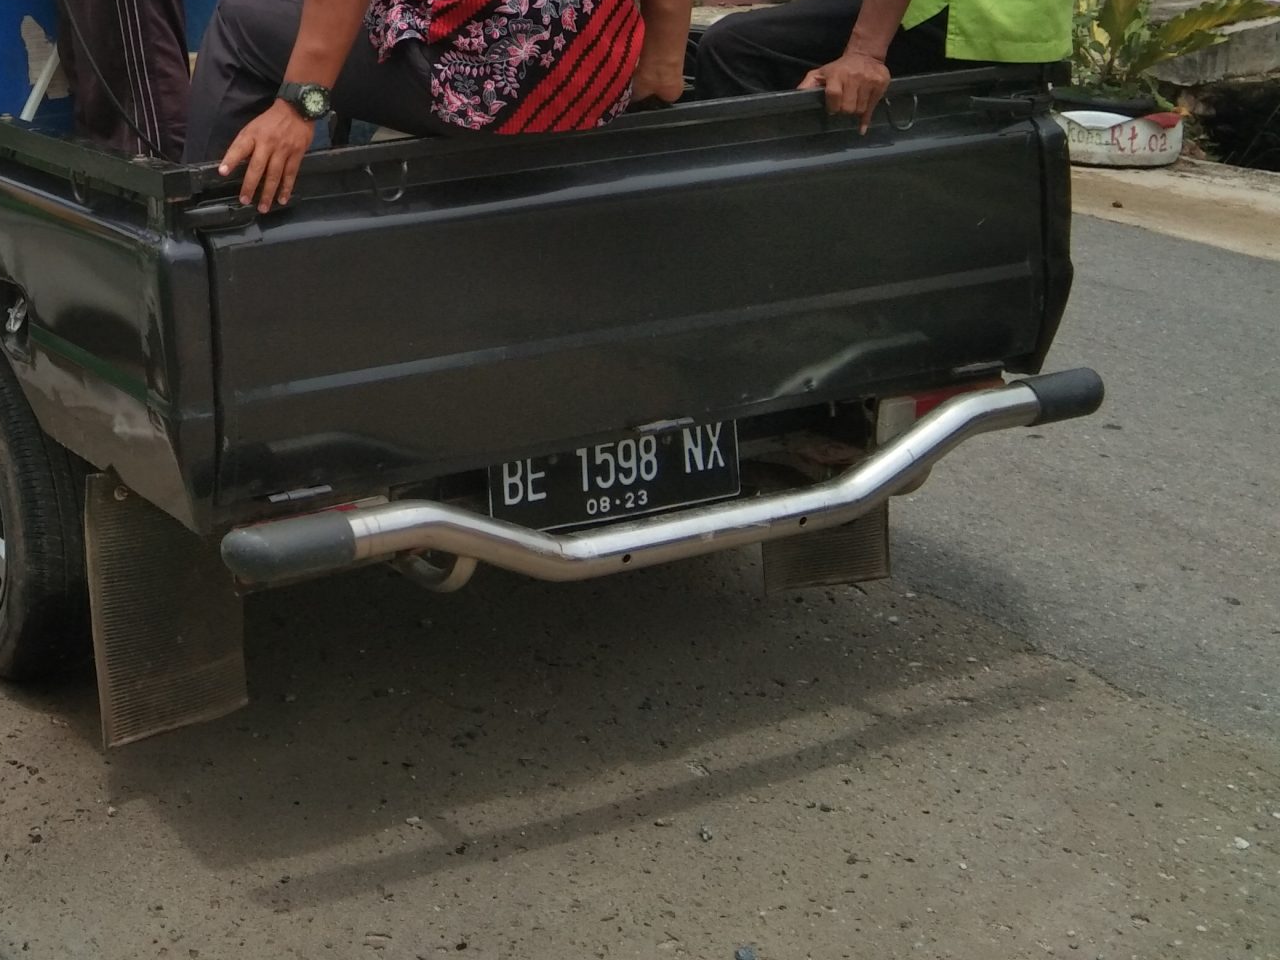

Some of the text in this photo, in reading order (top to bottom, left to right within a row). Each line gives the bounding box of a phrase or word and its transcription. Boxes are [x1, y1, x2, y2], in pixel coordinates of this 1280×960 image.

[502, 421, 726, 506] BE 1598 NX
